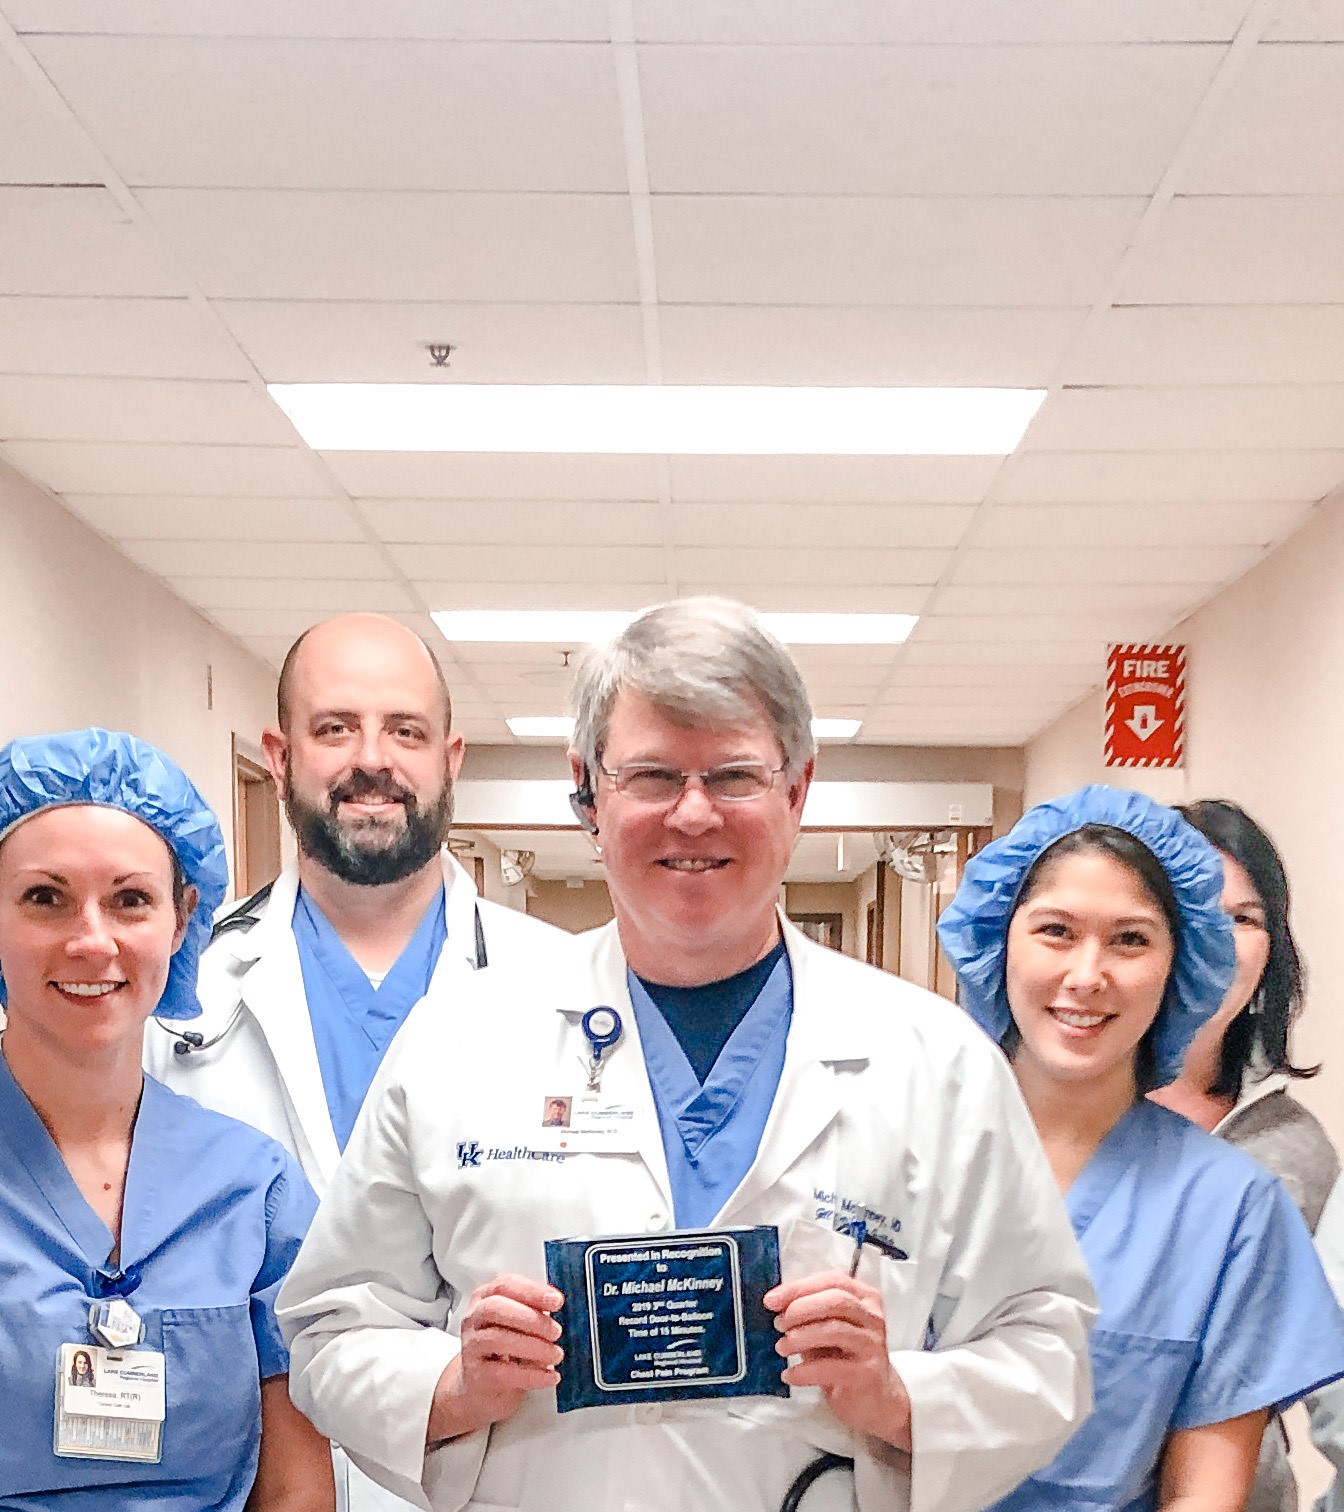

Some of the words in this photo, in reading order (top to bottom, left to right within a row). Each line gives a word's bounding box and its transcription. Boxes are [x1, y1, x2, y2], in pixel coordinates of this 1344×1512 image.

[1123, 659, 1170, 678] FIRE
[487, 1146, 565, 1164] HealthCare
[600, 1251, 649, 1263] Presented
[650, 1250, 661, 1260] in
[661, 1246, 723, 1260] Recognition
[603, 1283, 619, 1296] Dr.
[621, 1279, 665, 1295] Michael
[667, 1278, 724, 1291] McKinney
[628, 1328, 648, 1338] Time
